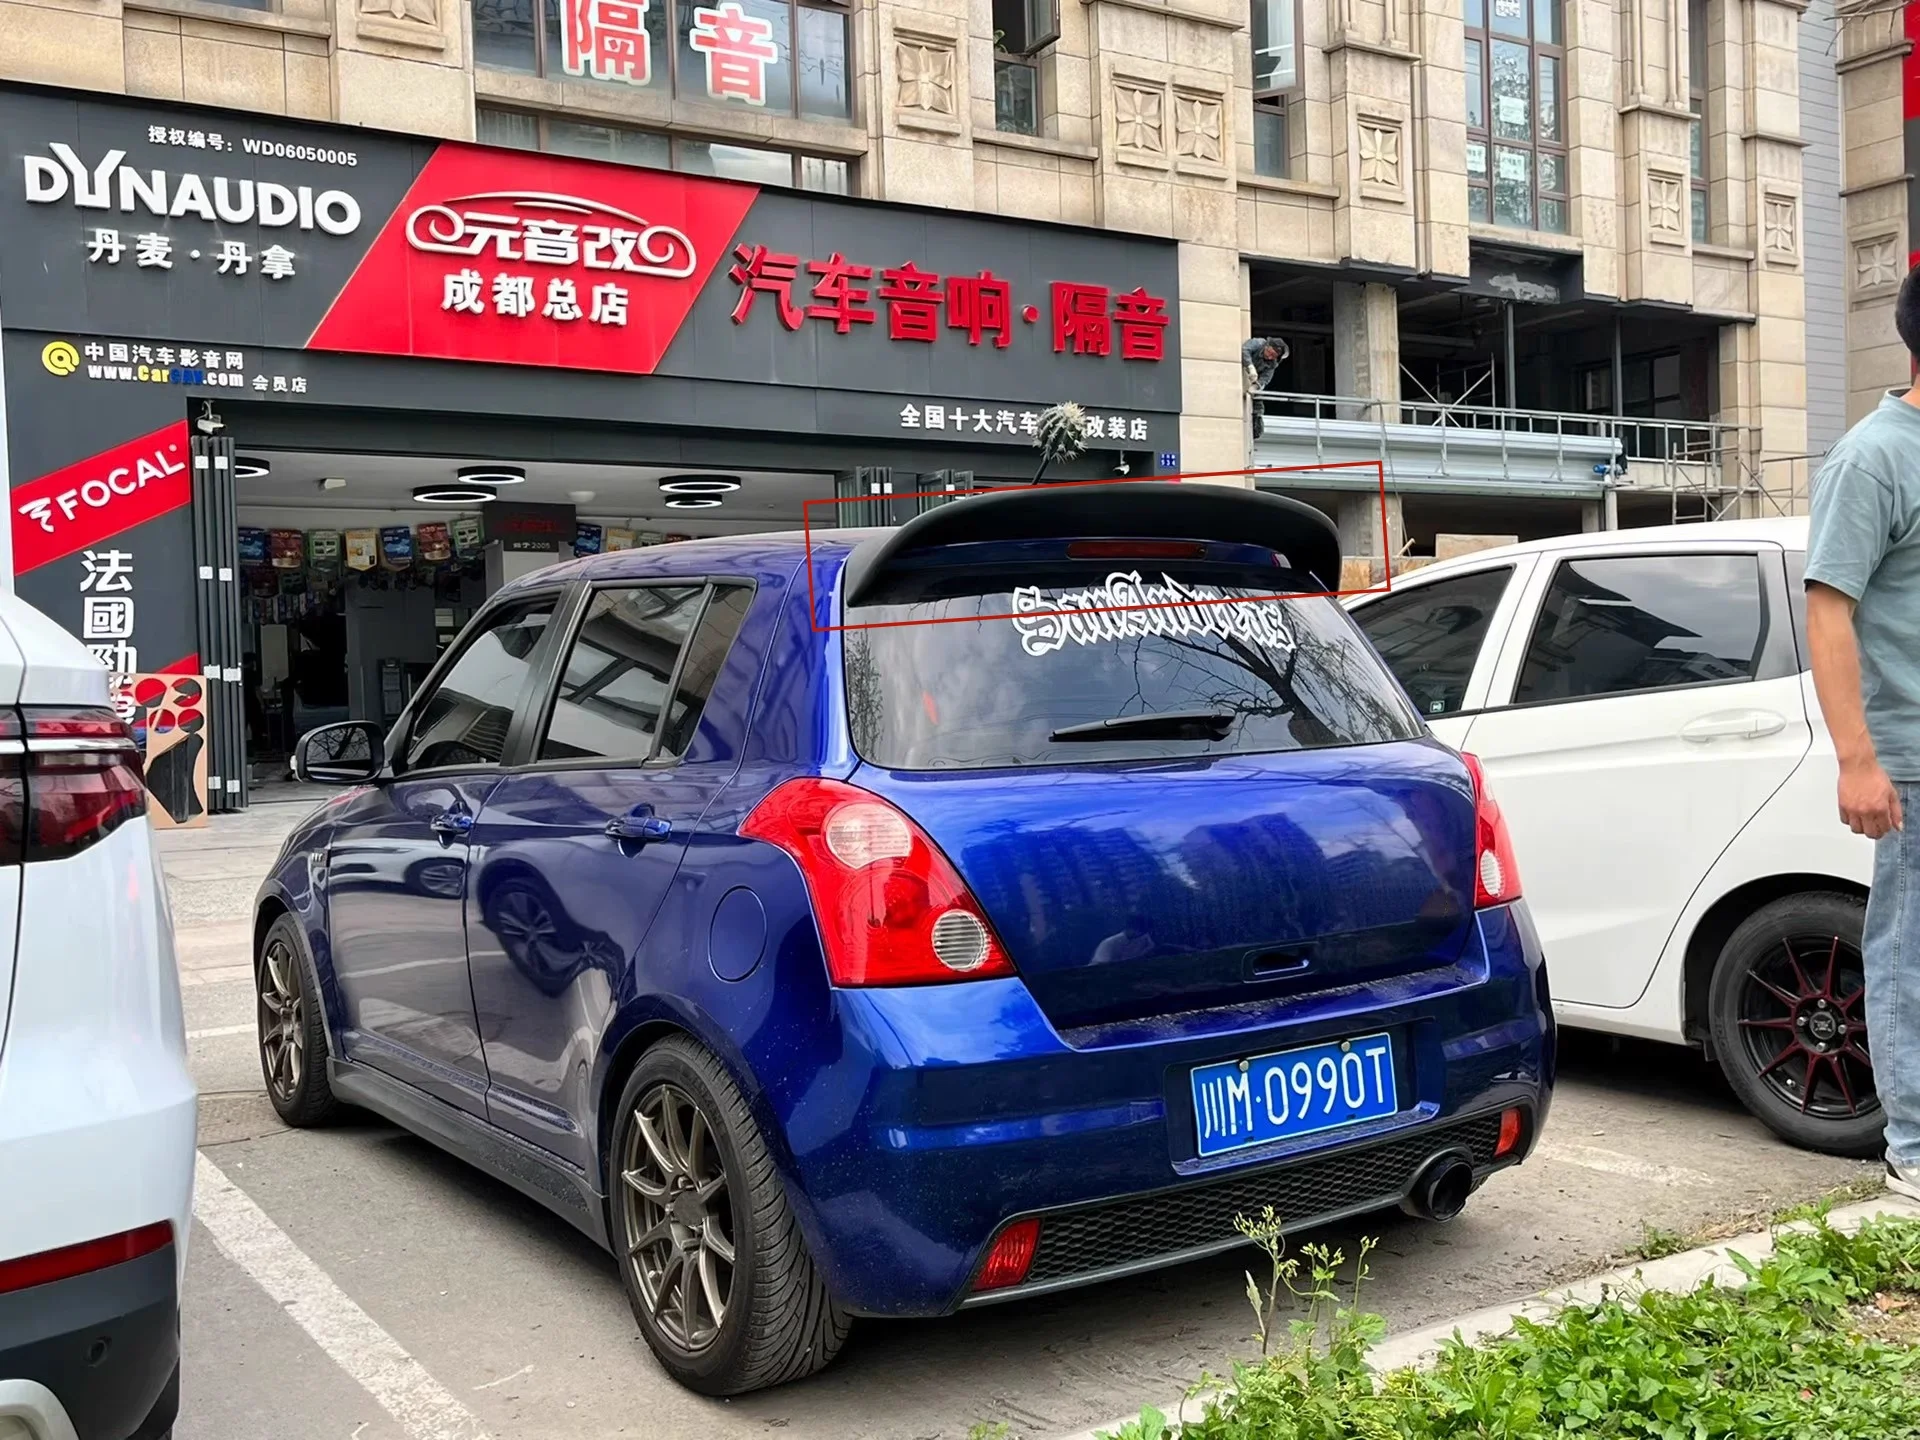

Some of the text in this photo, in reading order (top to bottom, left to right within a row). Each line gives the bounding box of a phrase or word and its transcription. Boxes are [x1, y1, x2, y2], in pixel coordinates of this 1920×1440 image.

[562, 0, 778, 103] 隔音
[243, 138, 357, 166] WD06050005
[24, 142, 361, 235] DYNAUDIO
[462, 210, 645, 272] 元音改
[441, 267, 629, 327] 成都总店
[84, 342, 244, 370] 中国汽车影音网
[252, 374, 307, 393] 会员店
[900, 403, 1148, 441] 全国十大汽车改装店
[55, 450, 186, 521] FOCAL
